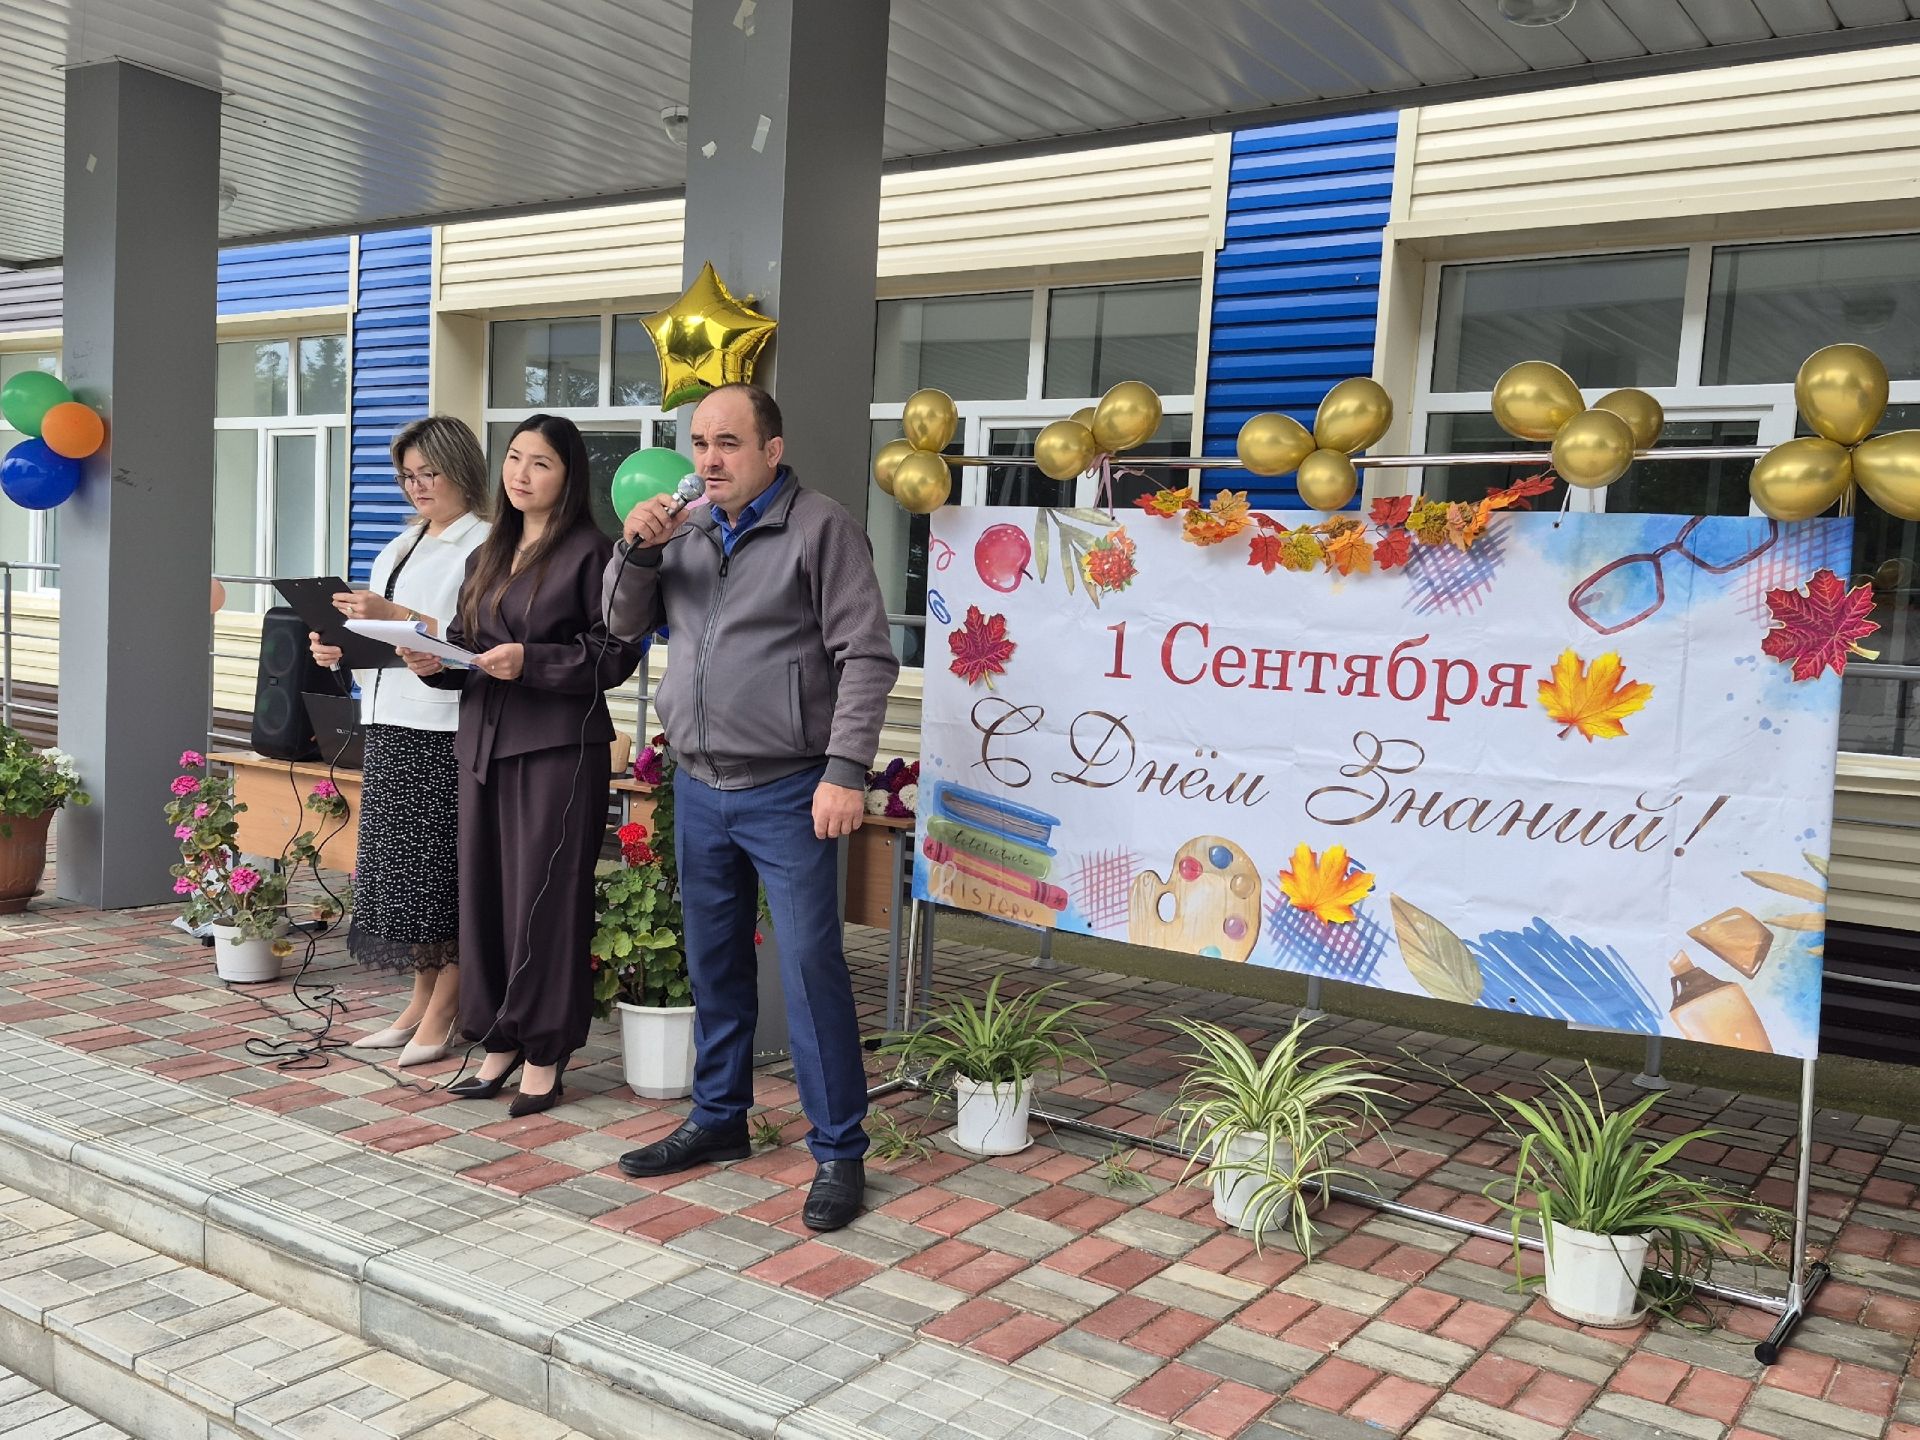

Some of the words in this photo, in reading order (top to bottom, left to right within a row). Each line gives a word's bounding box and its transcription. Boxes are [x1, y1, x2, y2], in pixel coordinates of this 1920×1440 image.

[1104, 621, 1132, 679] 1
[1160, 621, 1532, 722] Сентября
[970, 697, 1045, 788] С
[1051, 711, 1270, 806] Днём
